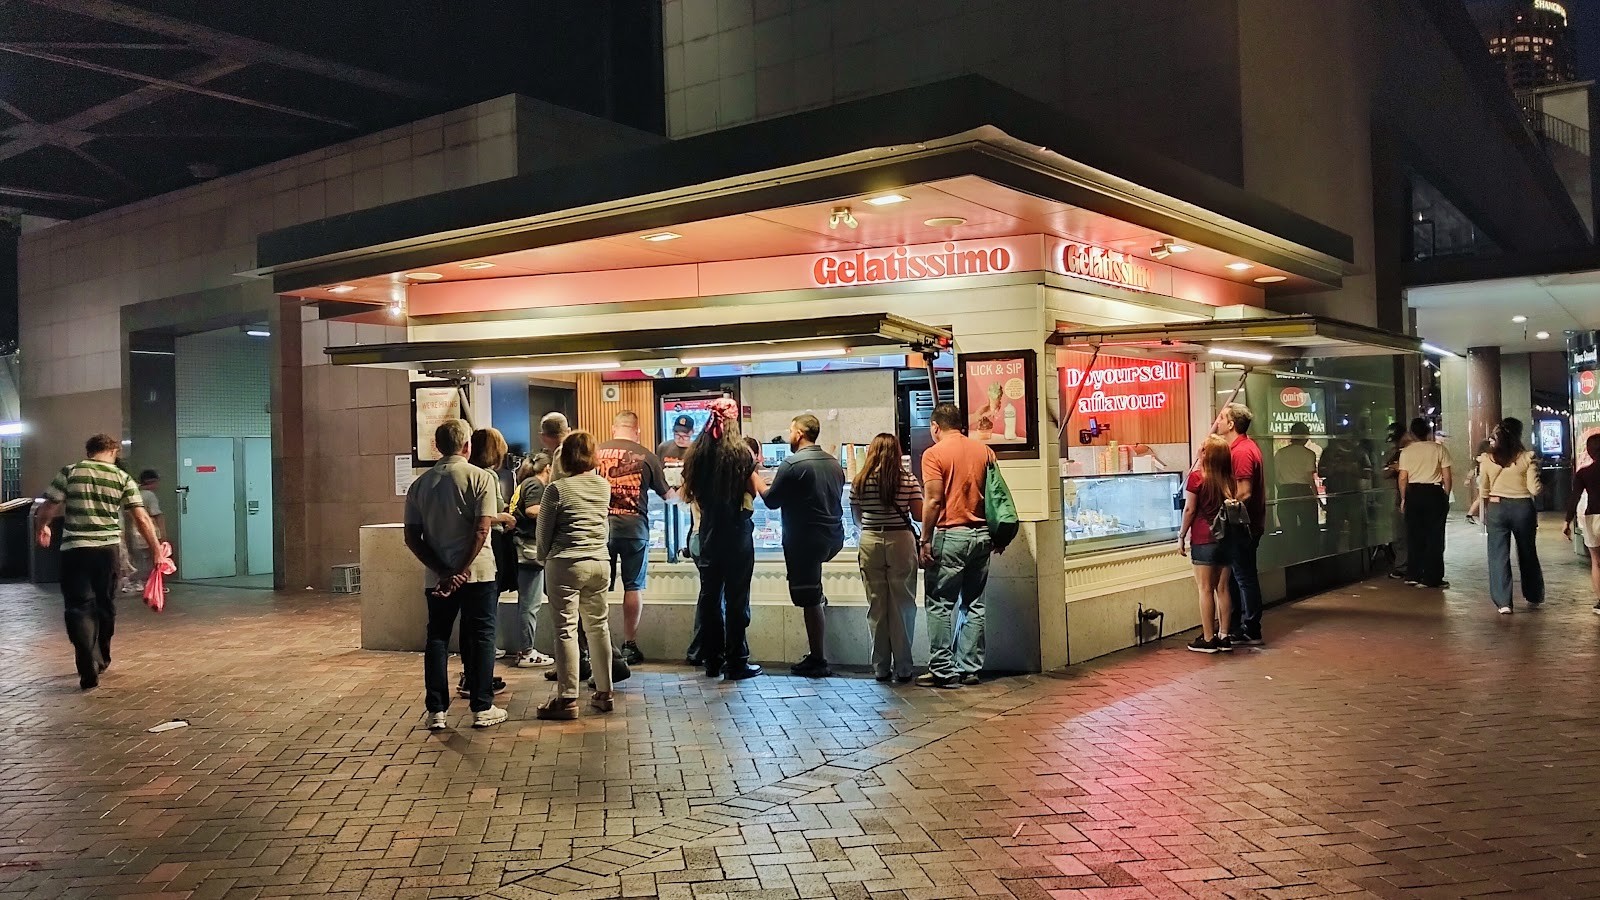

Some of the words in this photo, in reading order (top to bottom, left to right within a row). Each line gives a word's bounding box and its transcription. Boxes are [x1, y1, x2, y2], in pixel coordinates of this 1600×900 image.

[813, 243, 1011, 285] Gelatissimo
[1063, 244, 1152, 289] Gelatissimo
[970, 364, 993, 376] LICK
[995, 364, 1004, 375] &
[1006, 362, 1022, 374] SIP
